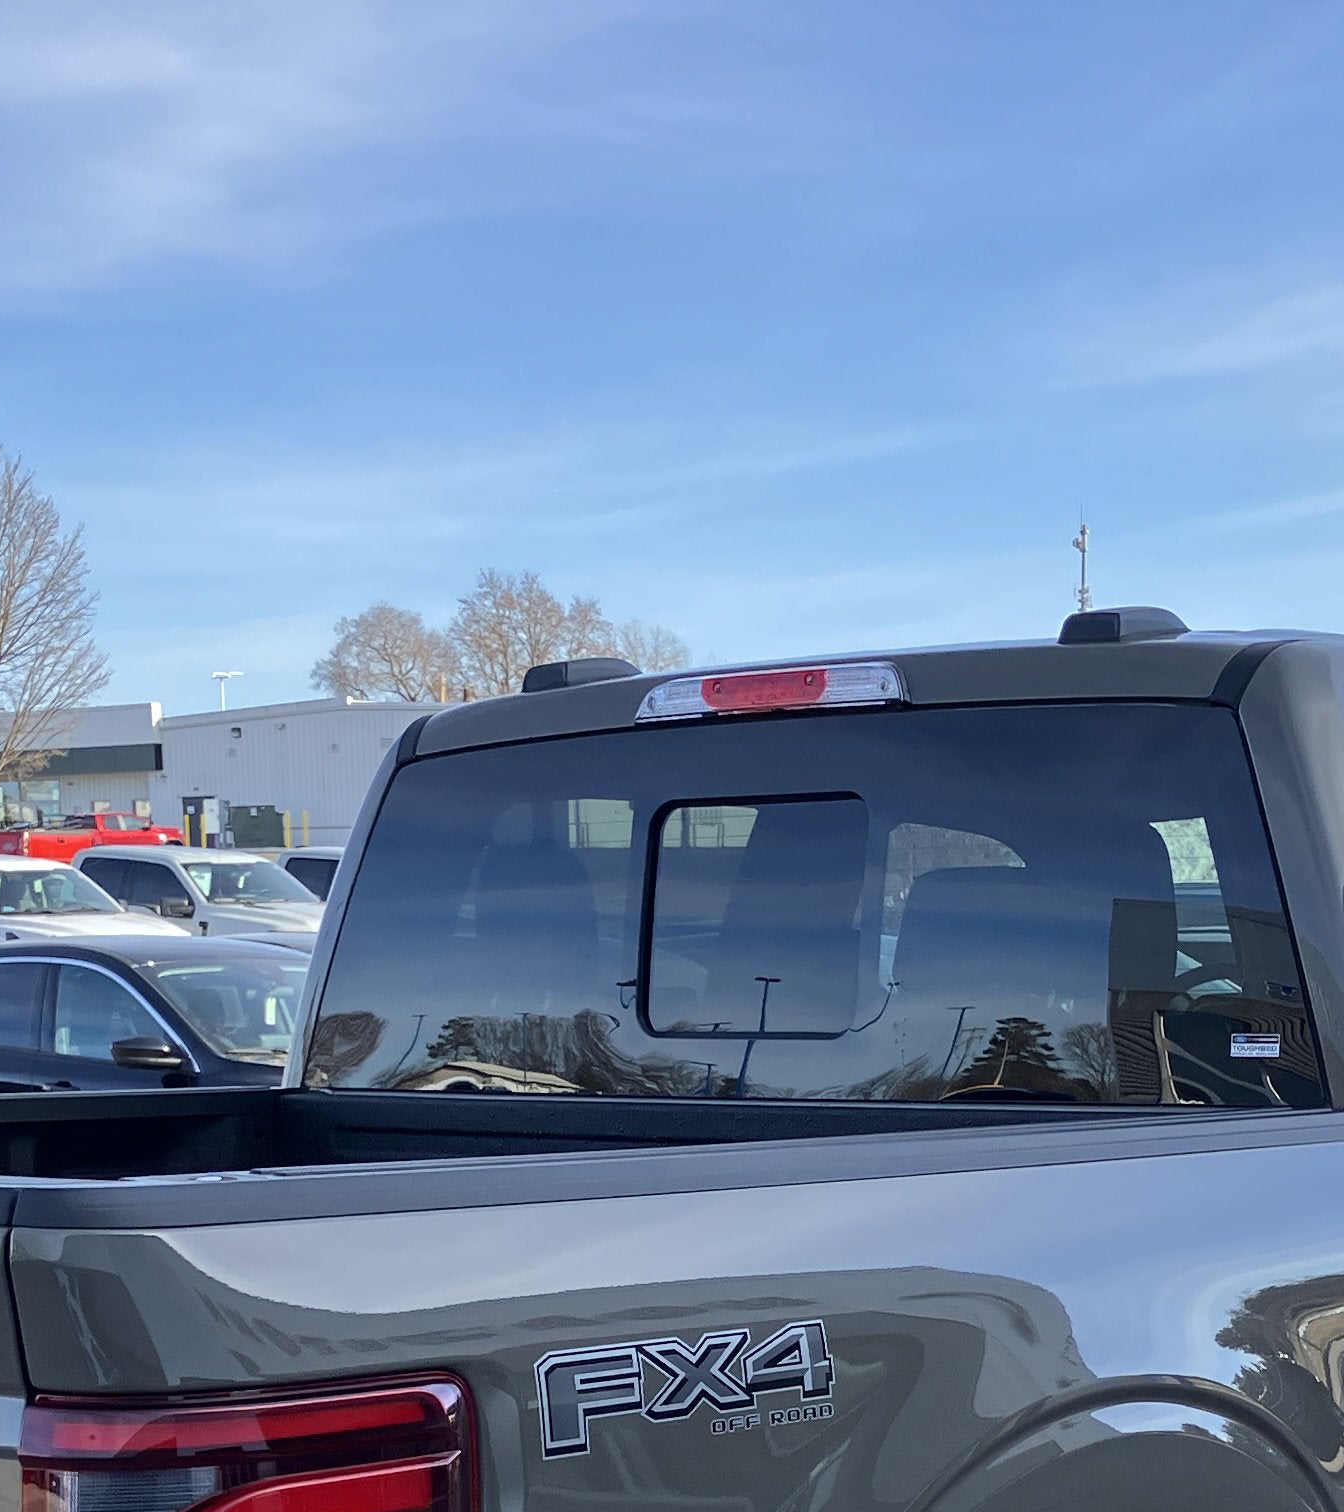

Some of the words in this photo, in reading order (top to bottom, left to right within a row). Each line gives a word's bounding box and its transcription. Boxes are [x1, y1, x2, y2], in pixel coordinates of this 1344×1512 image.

[534, 1319, 835, 1461] FX4
[711, 1413, 760, 1435] OFF
[769, 1403, 834, 1426] ROAD
